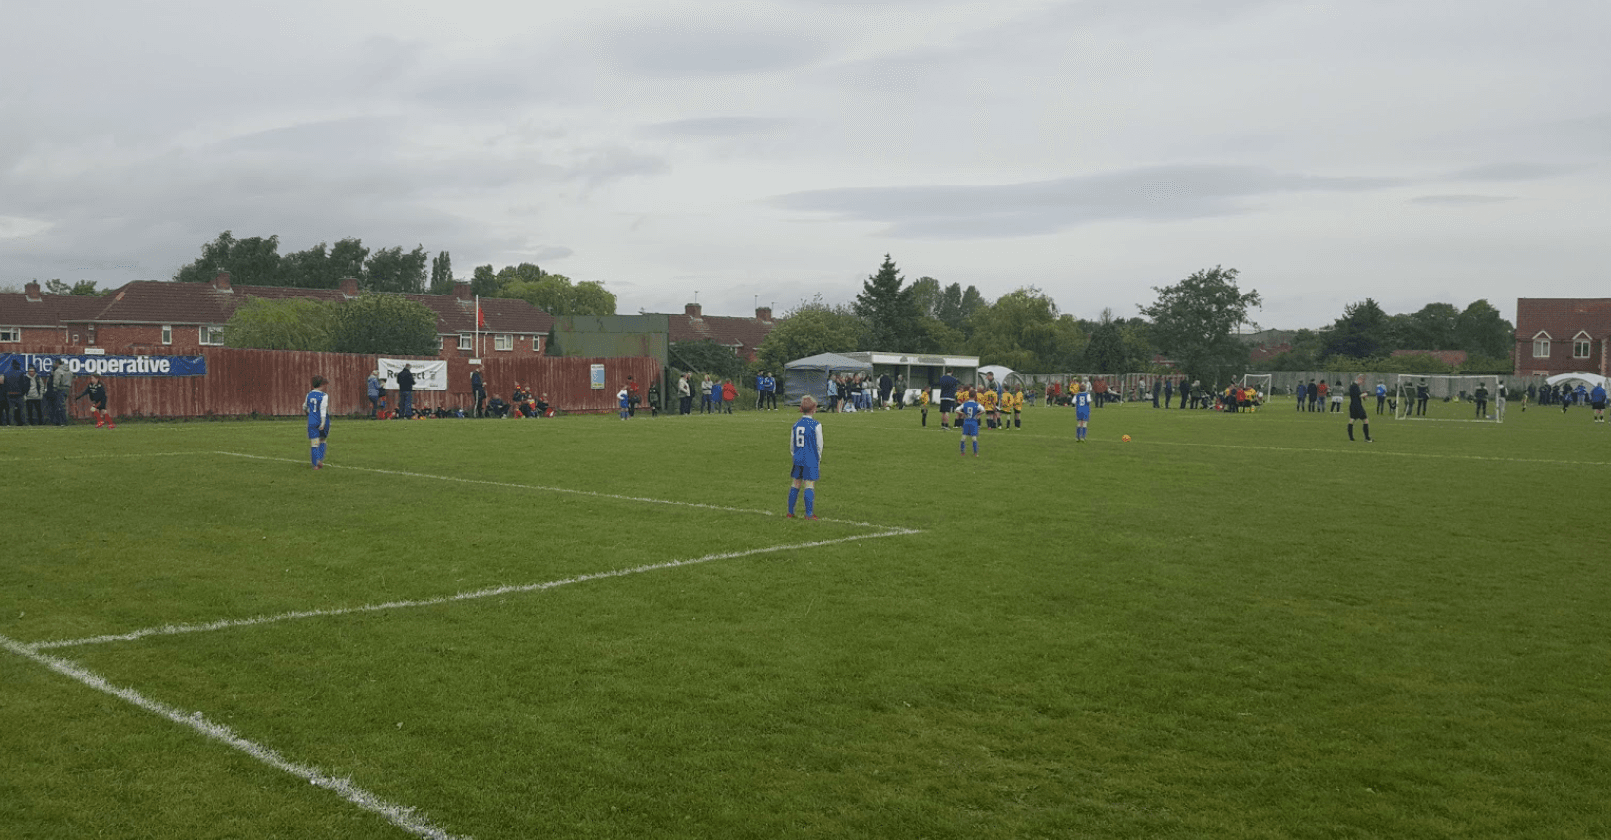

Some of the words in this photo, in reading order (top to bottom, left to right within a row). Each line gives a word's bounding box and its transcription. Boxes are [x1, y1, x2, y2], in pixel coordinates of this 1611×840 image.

[21, 353, 53, 372] The
[387, 370, 425, 380] Reect
[967, 406, 974, 419] 9
[796, 426, 805, 447] 6
